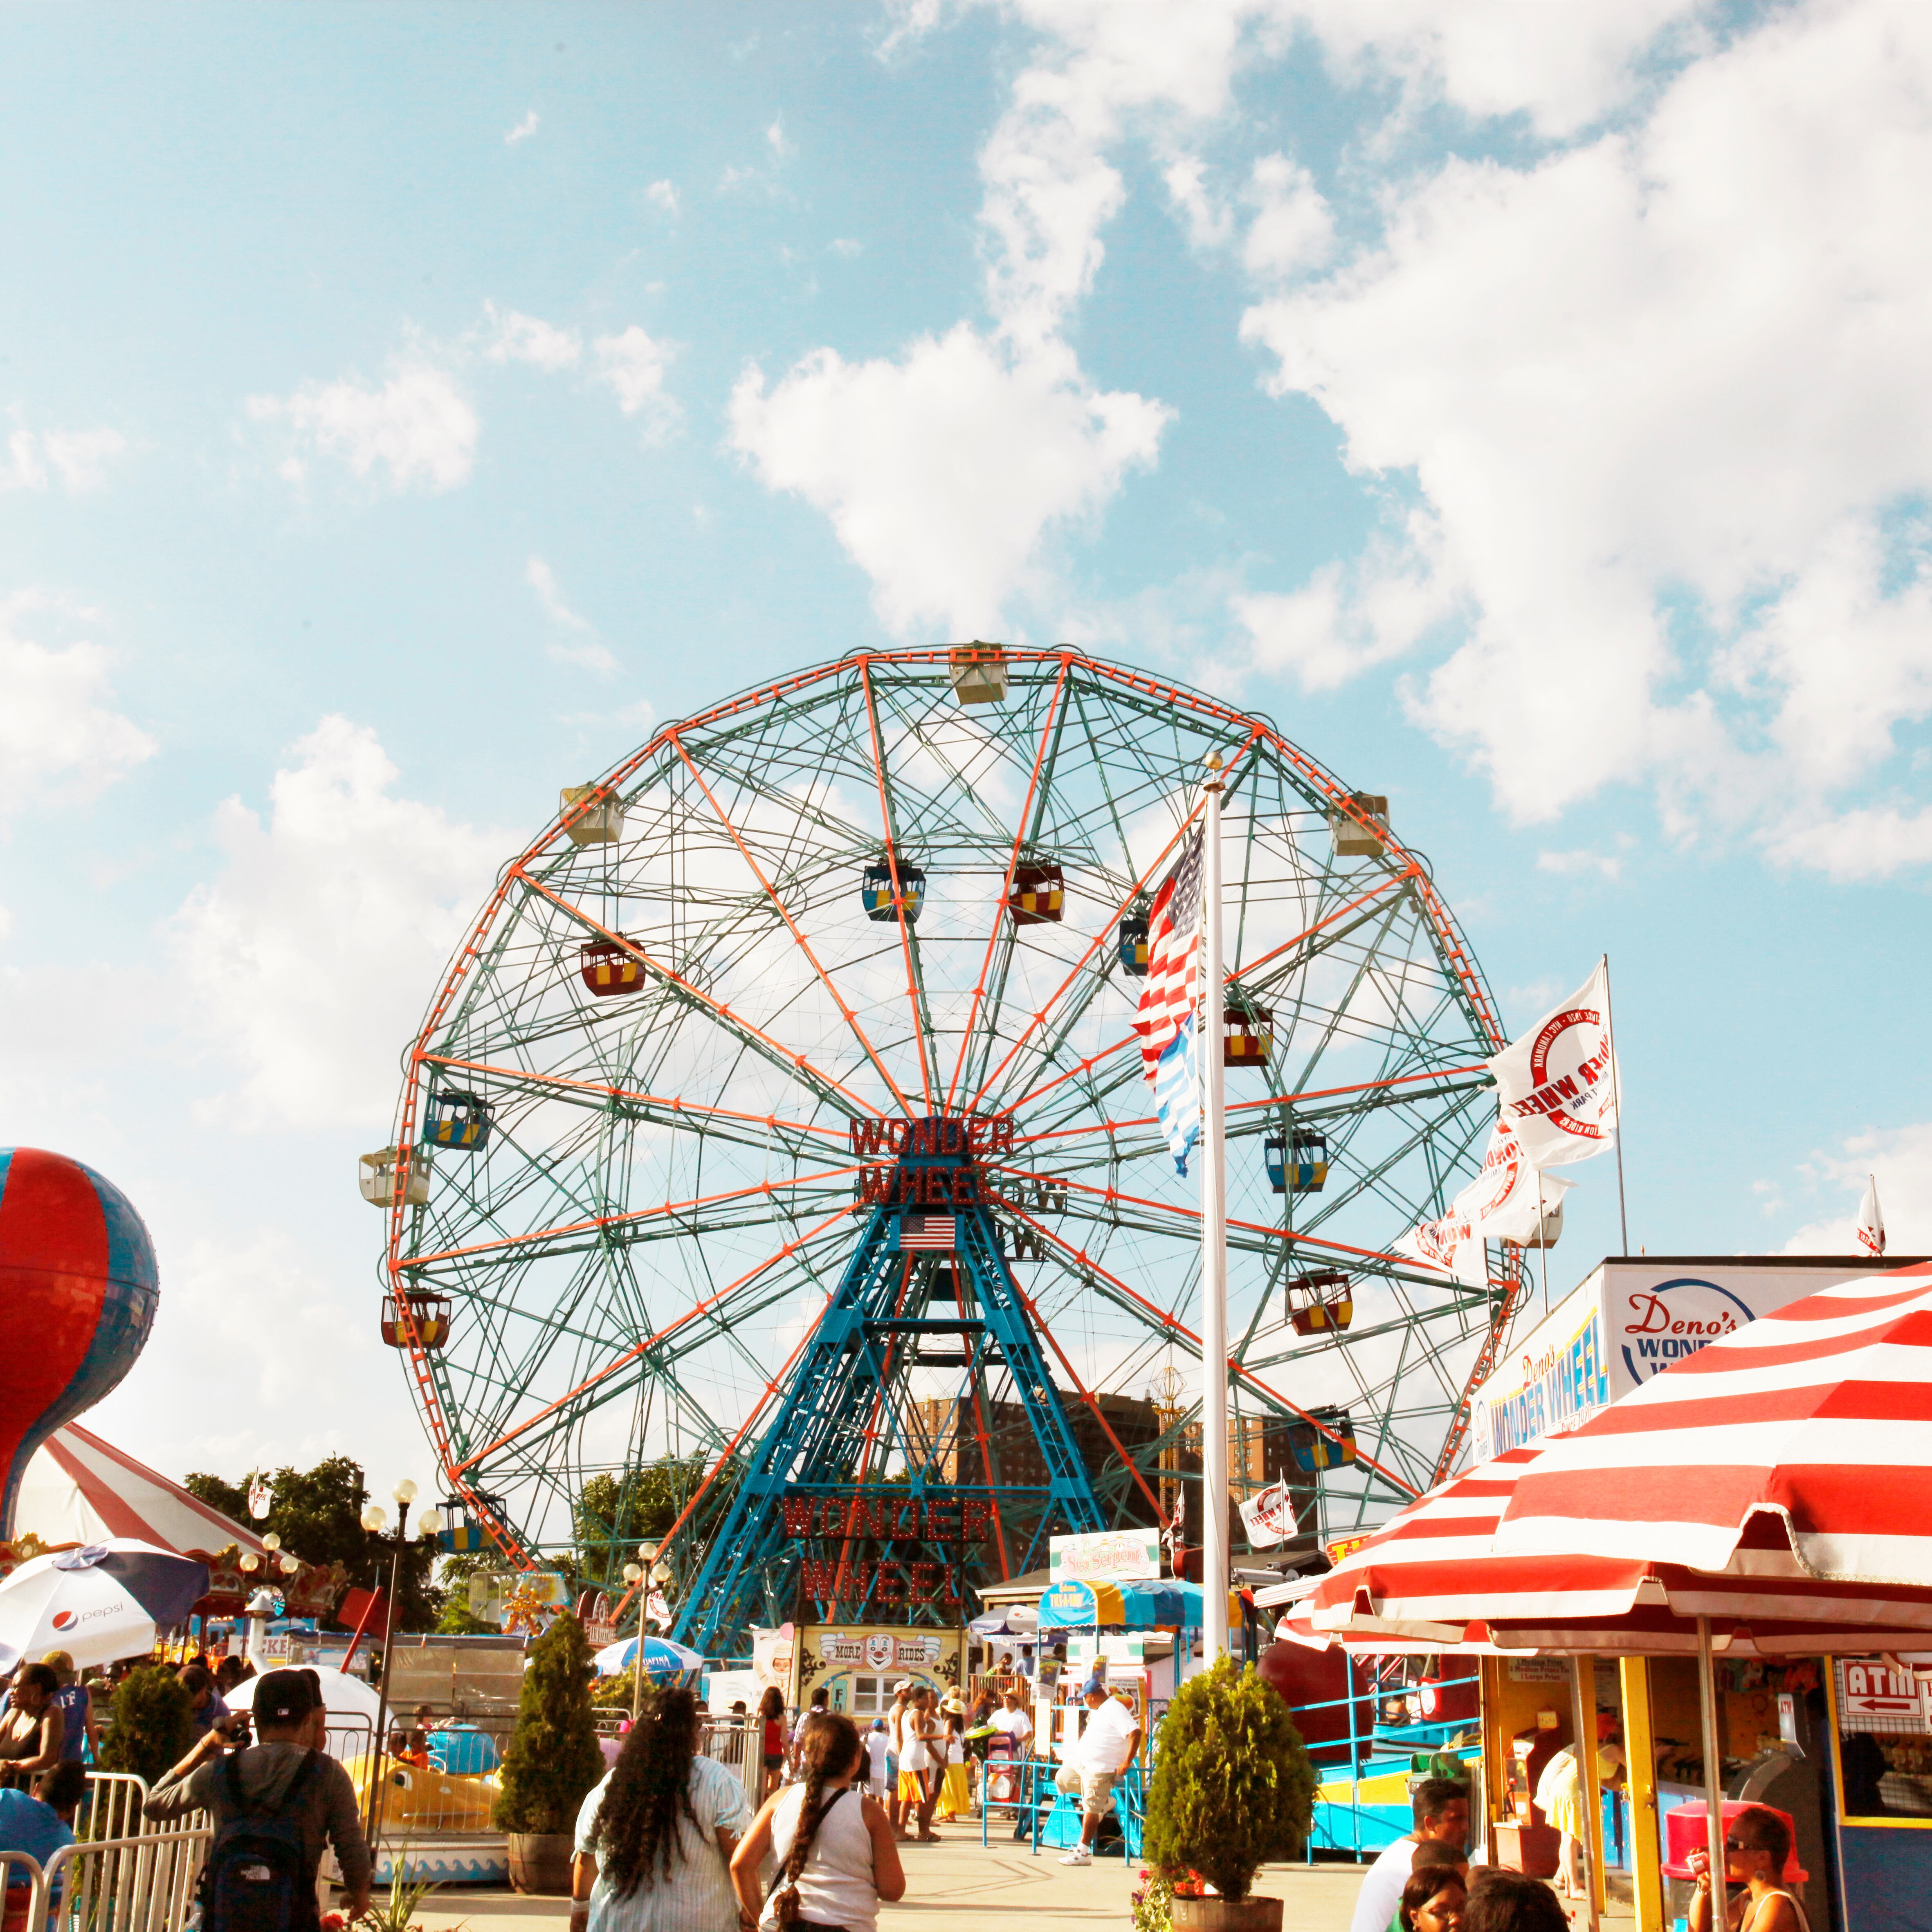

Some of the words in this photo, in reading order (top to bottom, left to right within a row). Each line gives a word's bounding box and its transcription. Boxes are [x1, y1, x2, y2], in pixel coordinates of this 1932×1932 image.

[851, 1118, 1013, 1155] WONDER
[859, 1167, 1000, 1204] WHEEL
[1625, 1294, 1737, 1334] Deno's
[1637, 1339, 1714, 1358] WON
[1489, 1381, 1546, 1458] WONDER
[1546, 1305, 1611, 1427] WHEEL
[1522, 1343, 1555, 1391] Deno's
[783, 1497, 989, 1542] WONDER
[1068, 1555, 1090, 1572] Sea
[1092, 1548, 1141, 1570] Serpent
[802, 1560, 961, 1604] WHEEL
[82, 1601, 123, 1622] pepsi
[643, 1654, 671, 1668] UAFINA
[835, 1645, 861, 1660] MORE
[898, 1646, 925, 1662] RIDES
[1849, 1666, 1916, 1696] ATM
[1780, 1701, 1792, 1714] ATM
